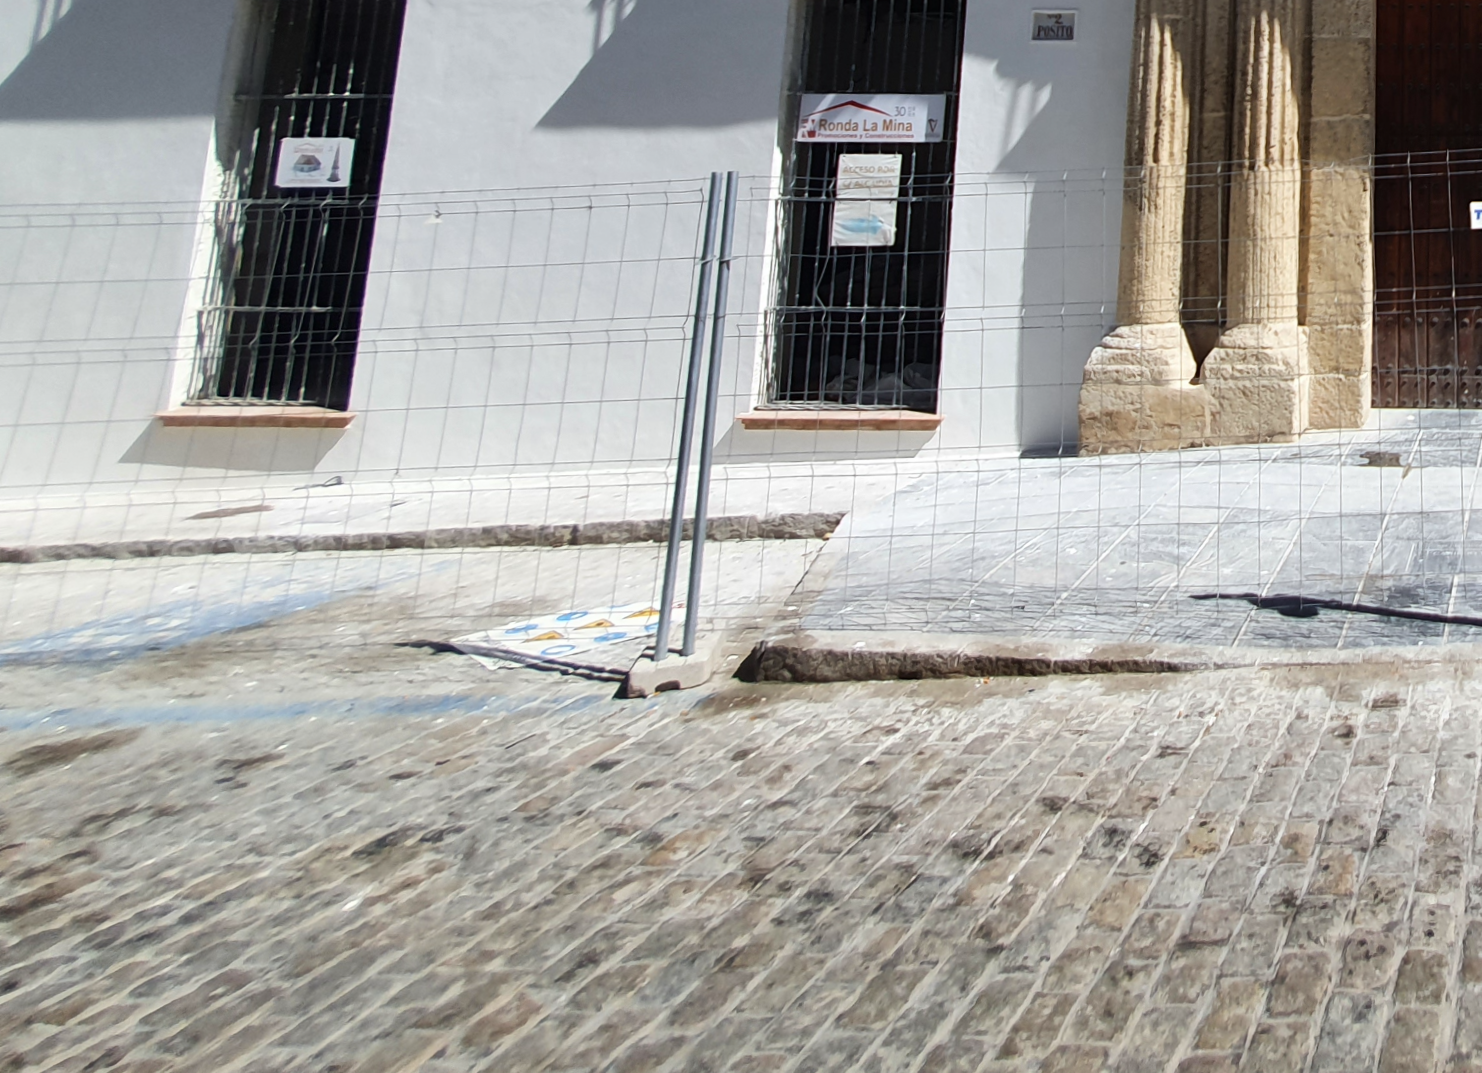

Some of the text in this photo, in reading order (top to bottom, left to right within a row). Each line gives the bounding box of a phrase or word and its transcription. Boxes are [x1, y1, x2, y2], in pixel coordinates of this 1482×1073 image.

[1055, 14, 1063, 25] 2
[894, 105, 907, 117] 30
[818, 118, 913, 132] Ronda La Mina
[842, 164, 876, 174] ACCESO
